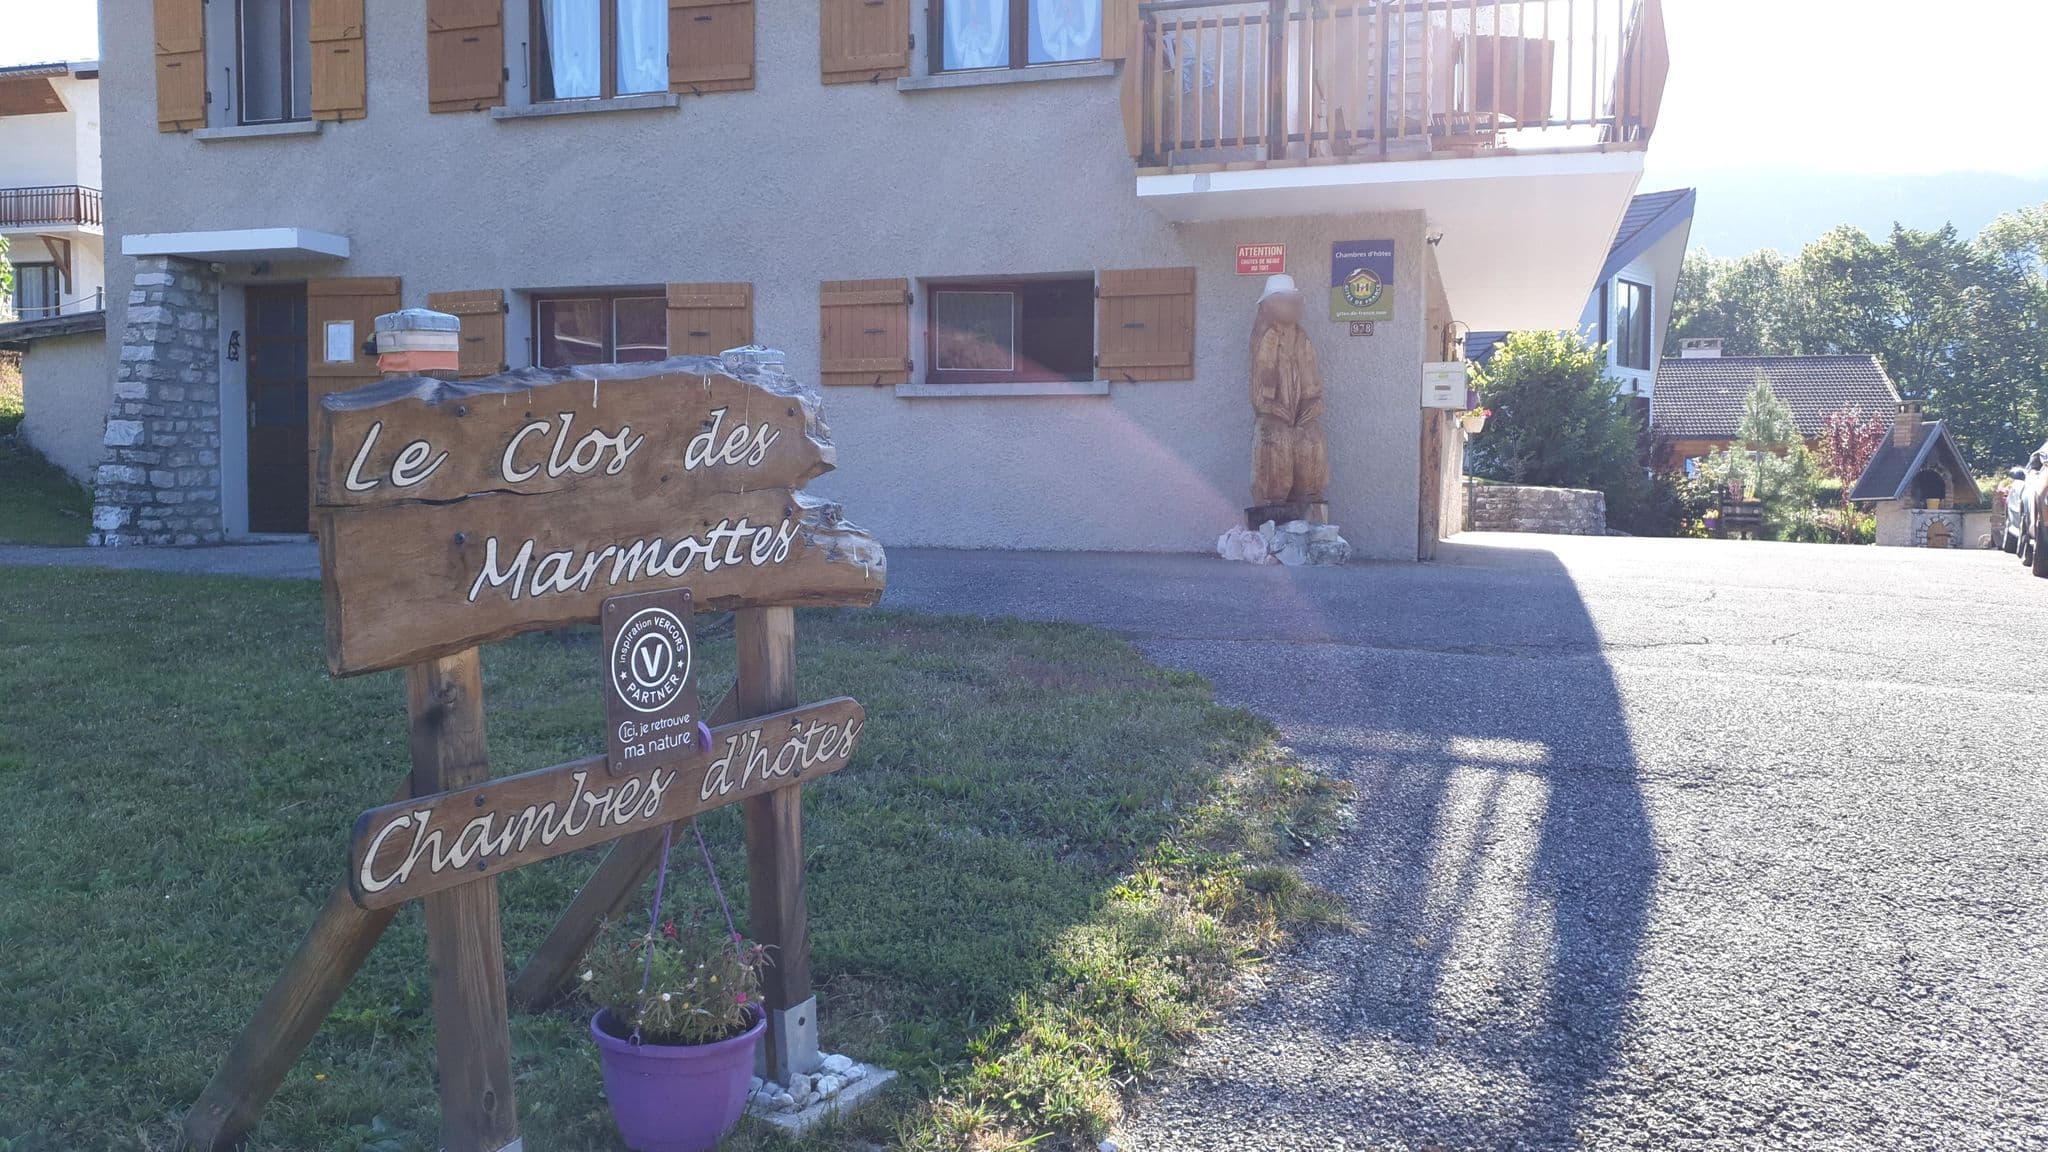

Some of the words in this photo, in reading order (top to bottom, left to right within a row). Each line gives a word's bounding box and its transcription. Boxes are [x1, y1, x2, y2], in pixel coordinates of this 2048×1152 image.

[1239, 246, 1283, 257] ATTENTION
[1365, 284, 1381, 304] FRANCE
[1353, 323, 1371, 333] 978
[344, 420, 448, 492] Le
[500, 410, 645, 483] Clos
[683, 407, 781, 471] des
[467, 517, 800, 604] Marmottes
[619, 619, 652, 663] inspiration
[654, 616, 685, 653] VERCORS
[640, 643, 663, 678] V
[626, 672, 680, 703] PARTNER
[639, 723, 649, 737] je
[650, 713, 690, 732] retrouve
[624, 743, 646, 760] ma
[649, 731, 691, 753] nature
[359, 767, 677, 894] Chambres
[701, 718, 865, 800] d'hôtes
